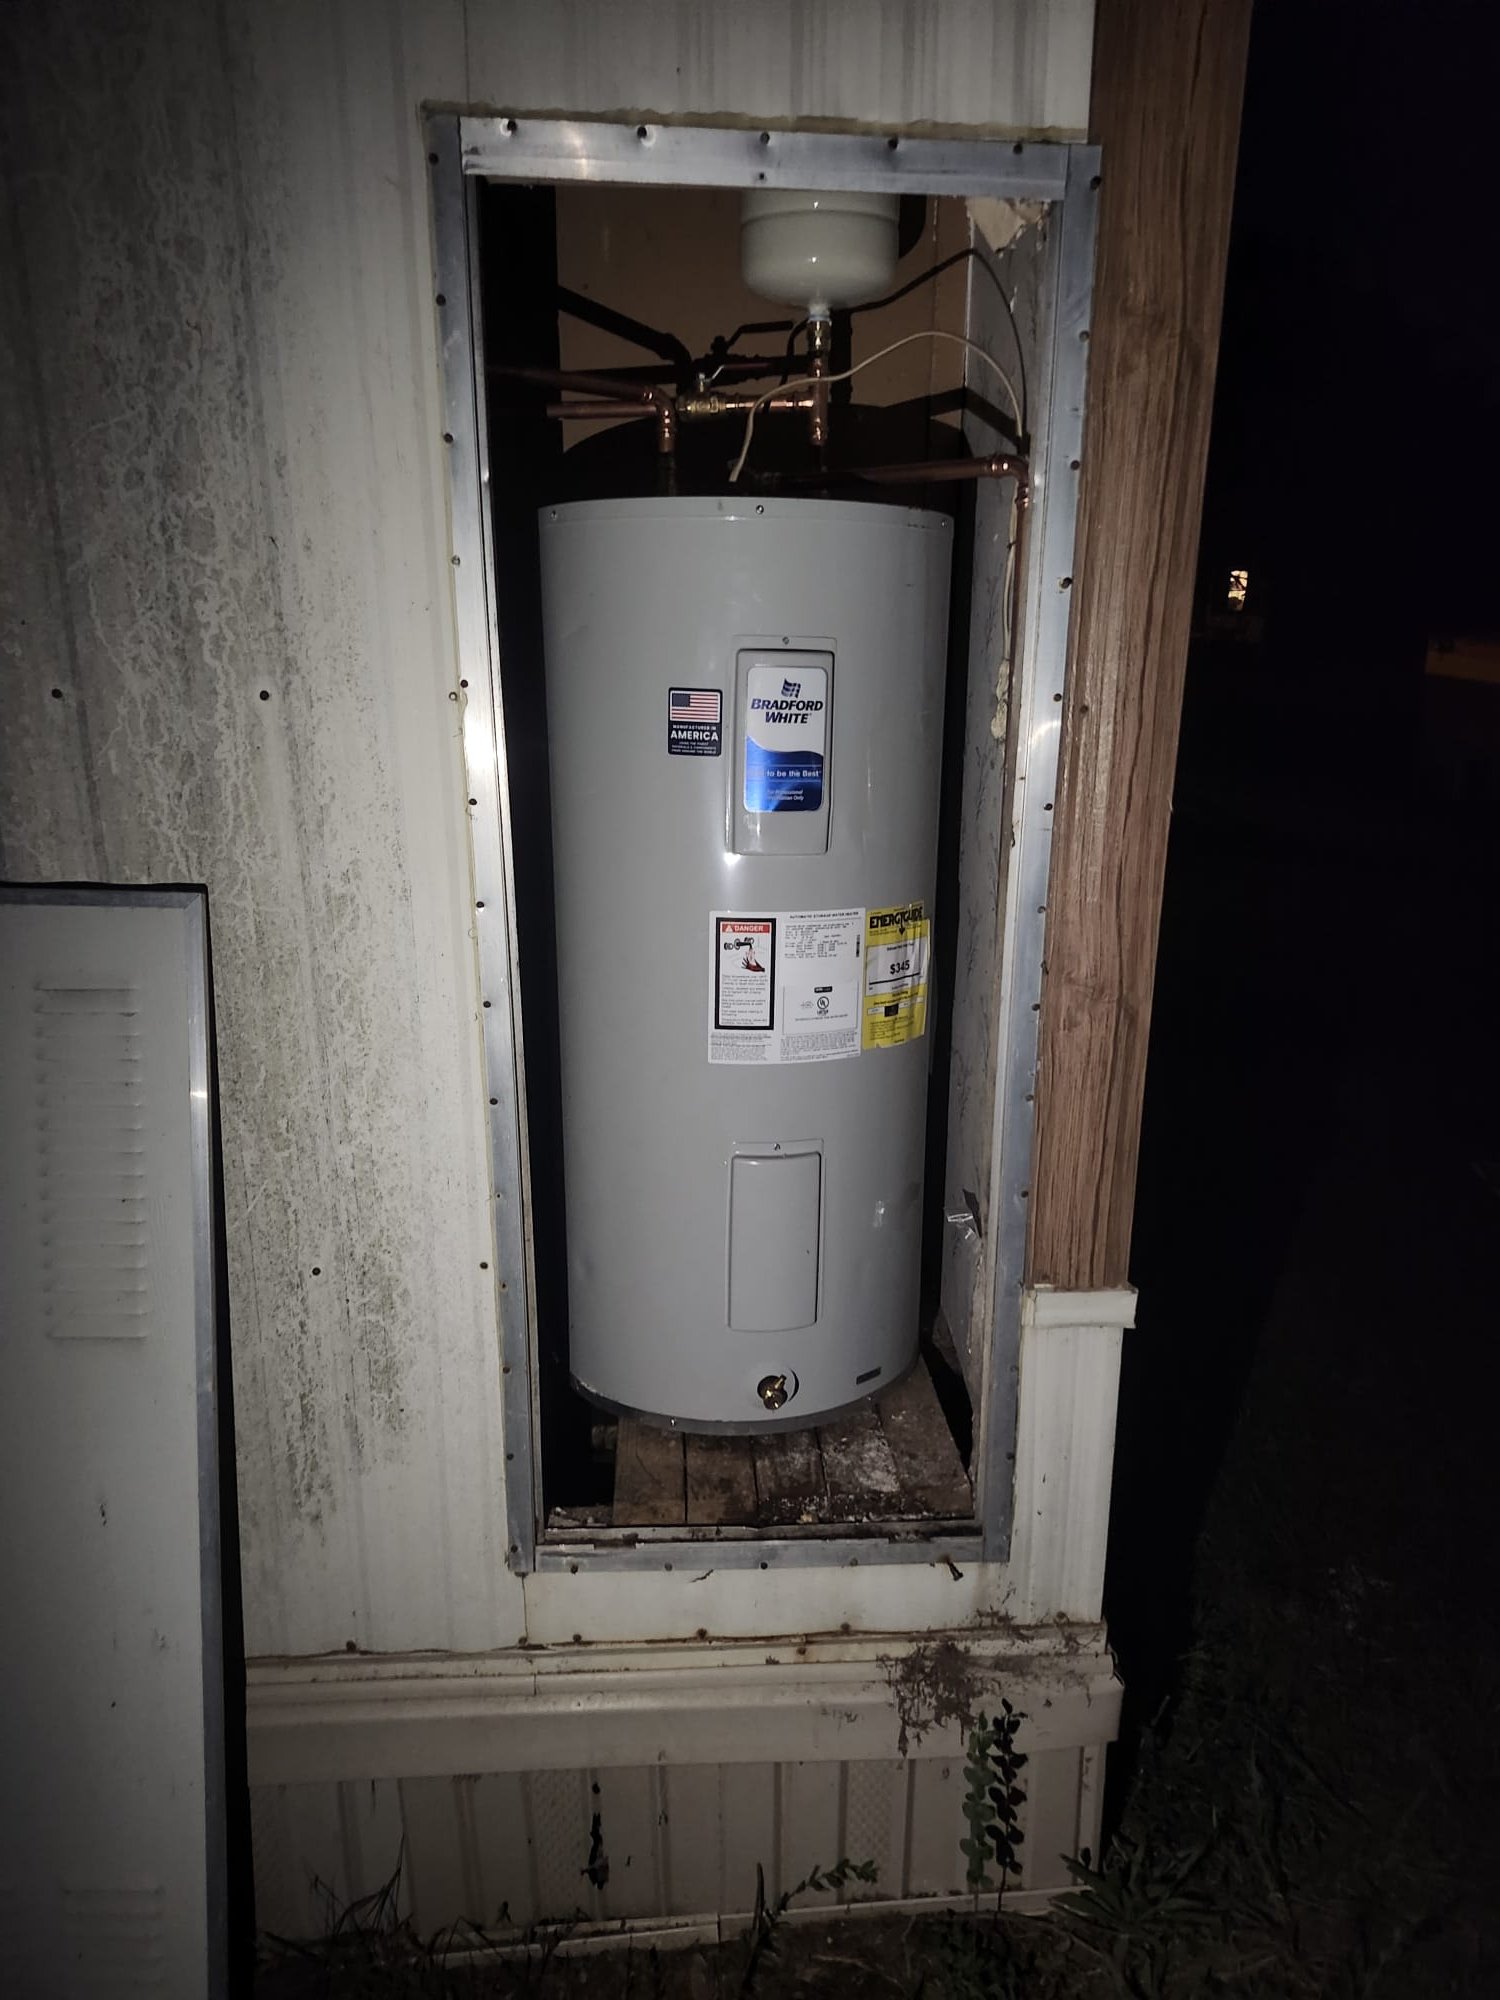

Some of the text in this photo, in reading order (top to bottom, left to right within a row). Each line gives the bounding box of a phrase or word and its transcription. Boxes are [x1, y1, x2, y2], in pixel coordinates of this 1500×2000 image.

[751, 698, 823, 711] BRADFORD
[765, 711, 809, 724] WHITE
[670, 730, 719, 741] AMERICA
[890, 960, 910, 975] $345
